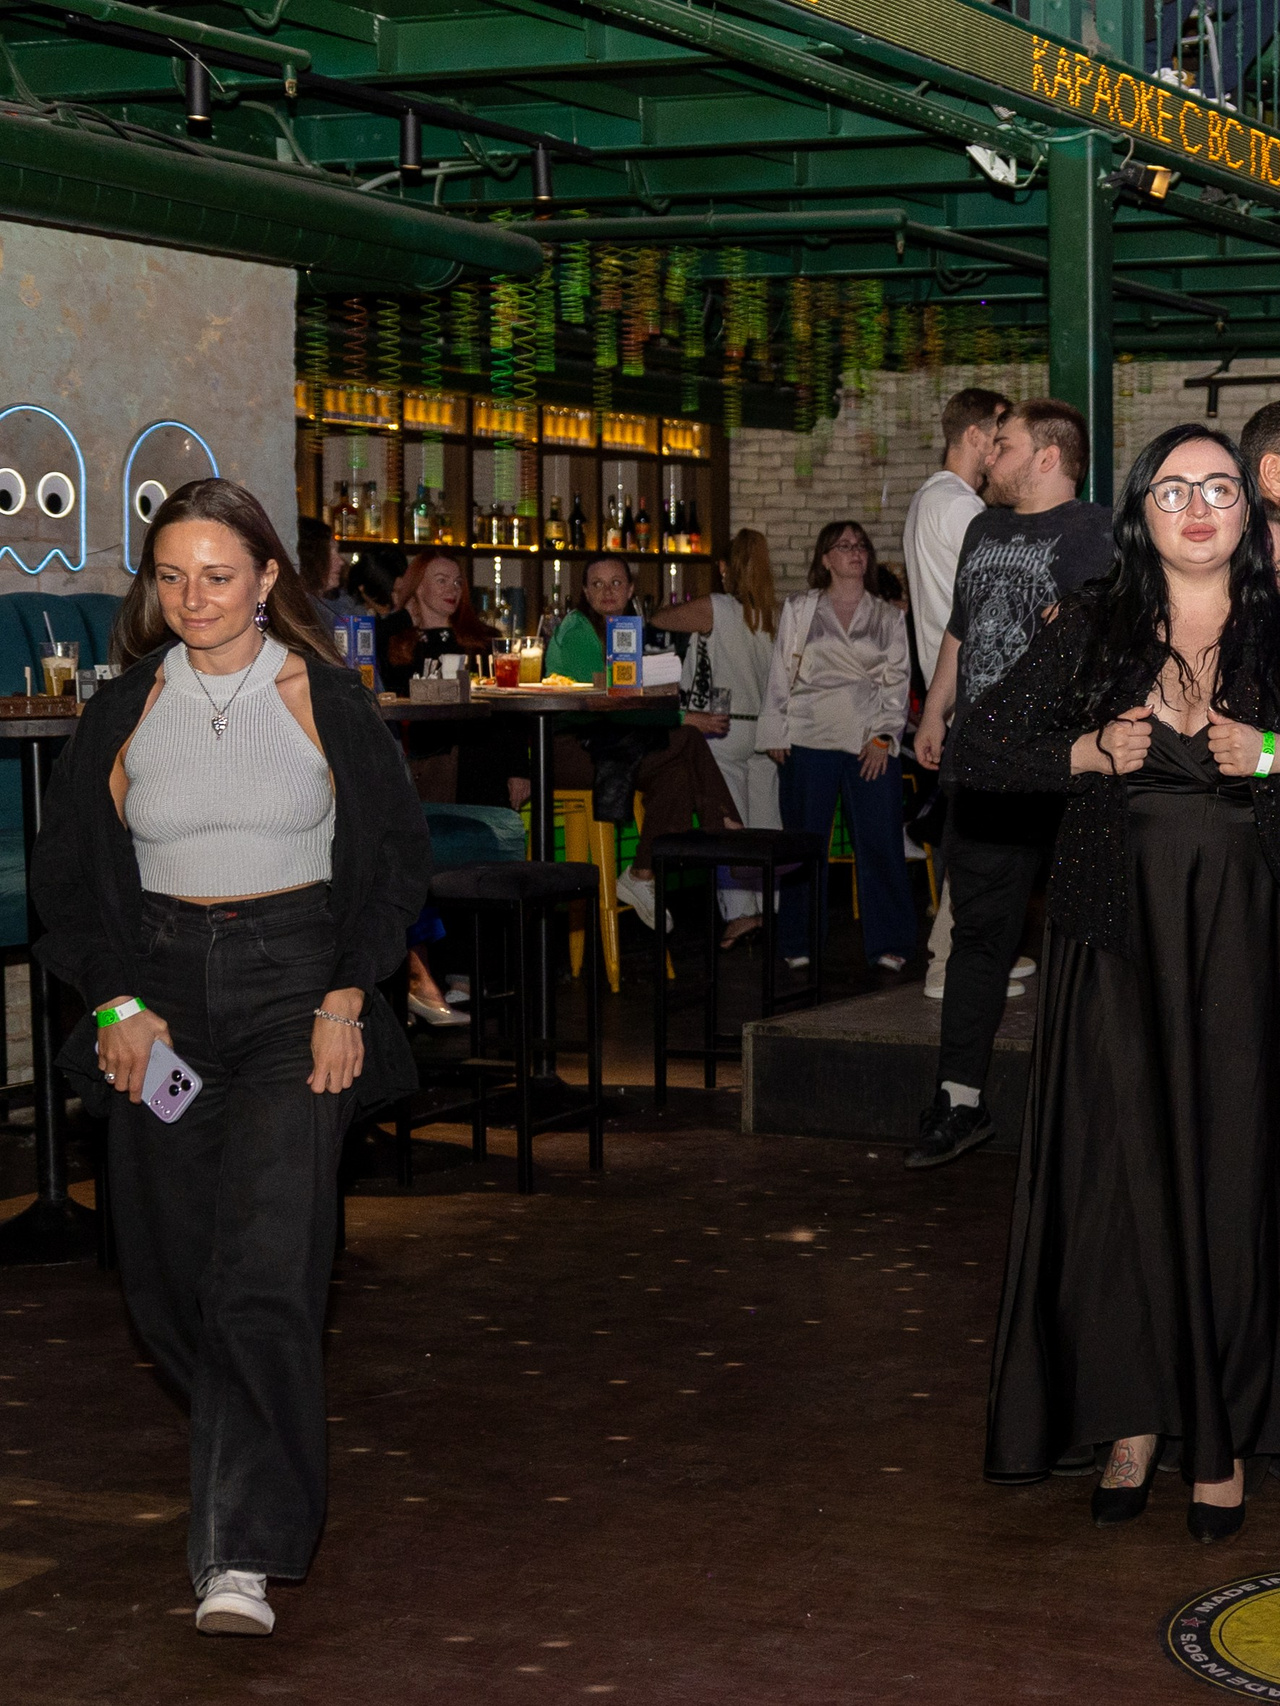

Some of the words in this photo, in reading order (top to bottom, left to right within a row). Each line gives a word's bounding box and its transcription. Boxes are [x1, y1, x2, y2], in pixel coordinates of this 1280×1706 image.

[1032, 35, 1172, 143] КАРАОКЕ
[1179, 101, 1202, 153] С
[1208, 110, 1244, 169] ВС
[1194, 1583, 1260, 1613] MADE
[1180, 1633, 1210, 1664] 90'S
[1201, 1663, 1232, 1678] IN
